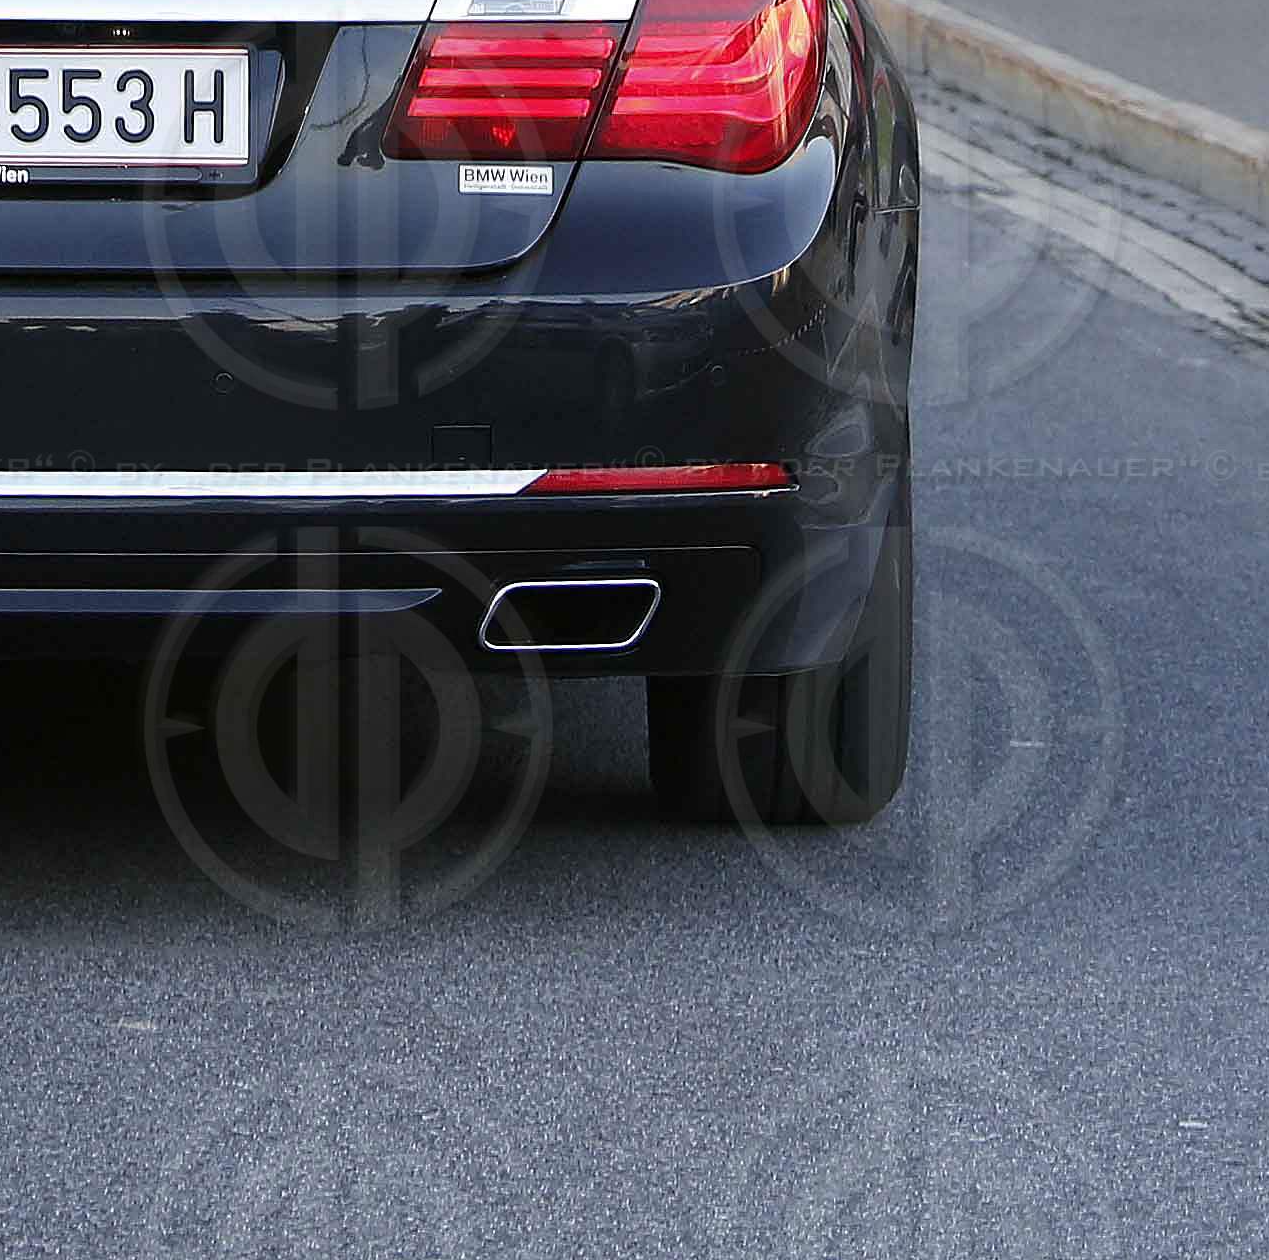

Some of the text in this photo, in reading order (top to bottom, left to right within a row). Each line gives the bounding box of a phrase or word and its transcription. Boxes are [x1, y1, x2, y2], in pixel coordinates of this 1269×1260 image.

[182, 67, 225, 144] H
[464, 168, 548, 183] BMW Wien
